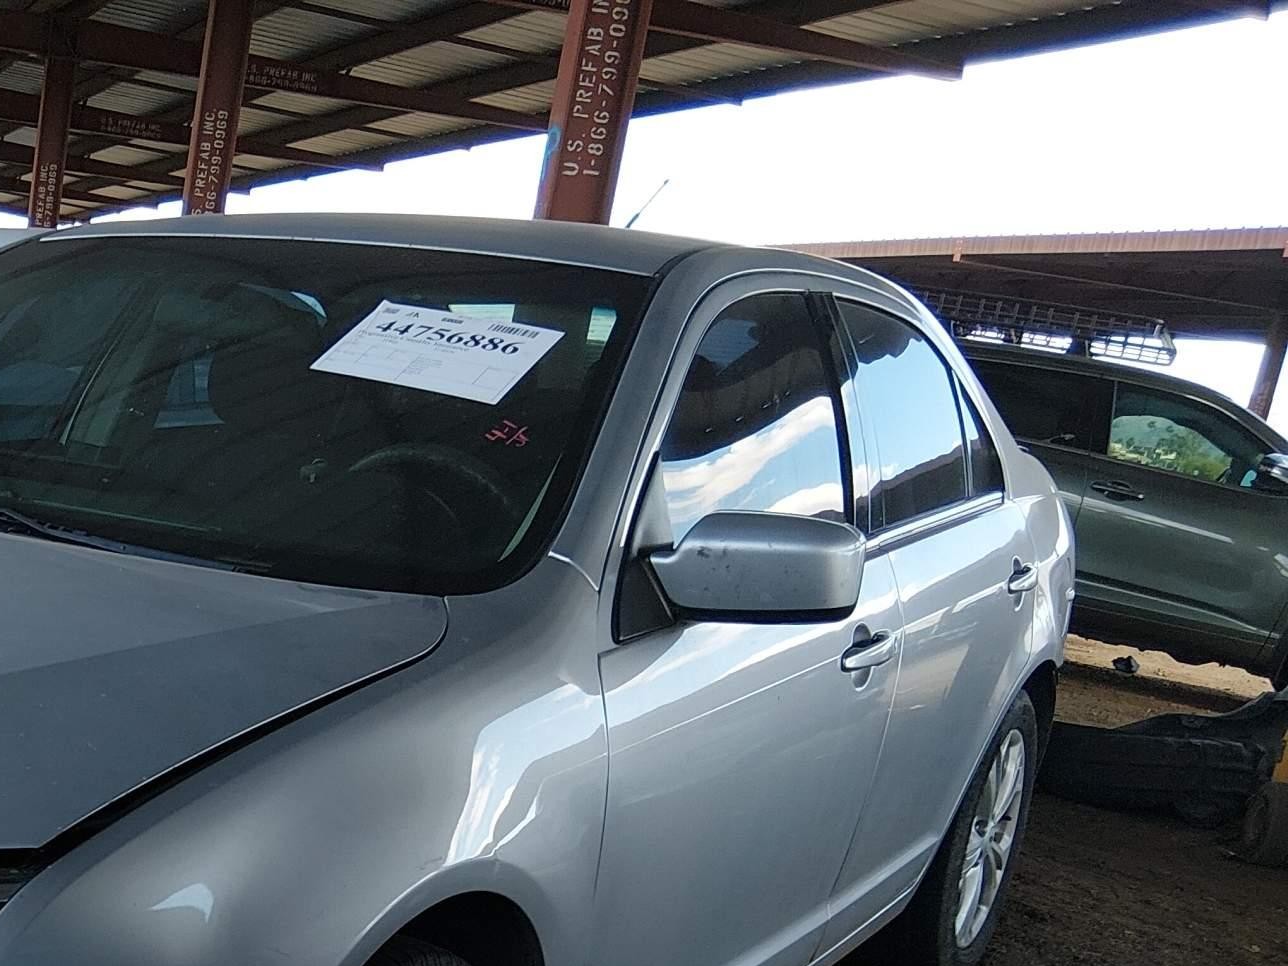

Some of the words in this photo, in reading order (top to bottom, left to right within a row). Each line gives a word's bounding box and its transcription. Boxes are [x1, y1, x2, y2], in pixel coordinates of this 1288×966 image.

[573, 27, 605, 119] PREFAB
[202, 108, 217, 136] INC.
[194, 142, 212, 197] PREFAB
[562, 134, 586, 176] U.S.
[34, 186, 47, 226] PREFAB
[375, 319, 528, 356] 44756886
